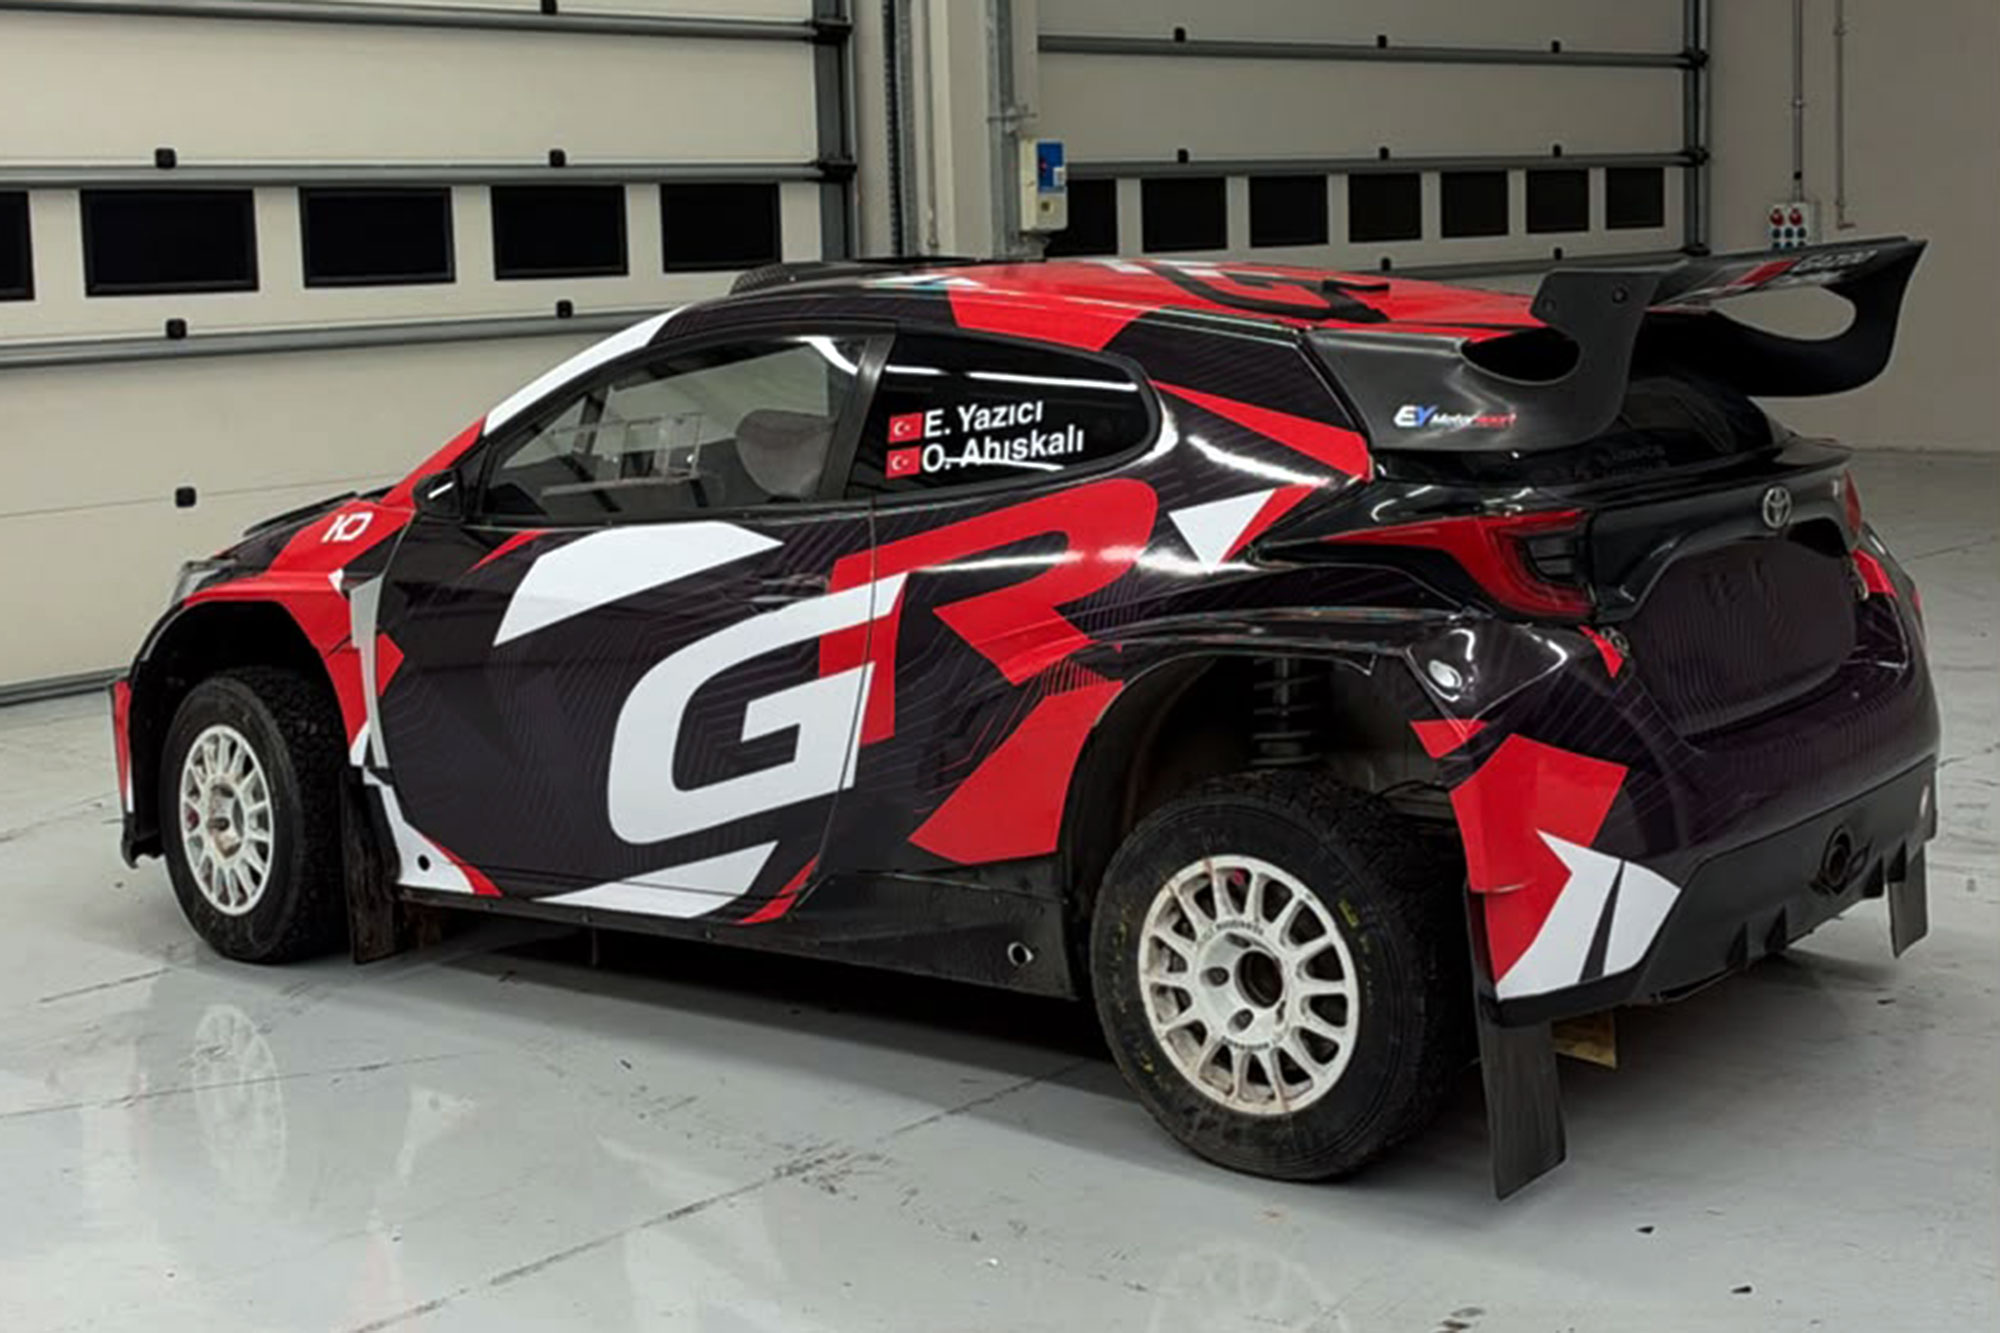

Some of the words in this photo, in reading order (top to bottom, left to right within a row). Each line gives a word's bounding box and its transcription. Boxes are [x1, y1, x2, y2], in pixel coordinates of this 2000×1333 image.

[923, 408, 951, 438] E.
[957, 401, 1043, 433] Yazıcı
[1393, 404, 1438, 428] EY
[921, 443, 951, 473] O.
